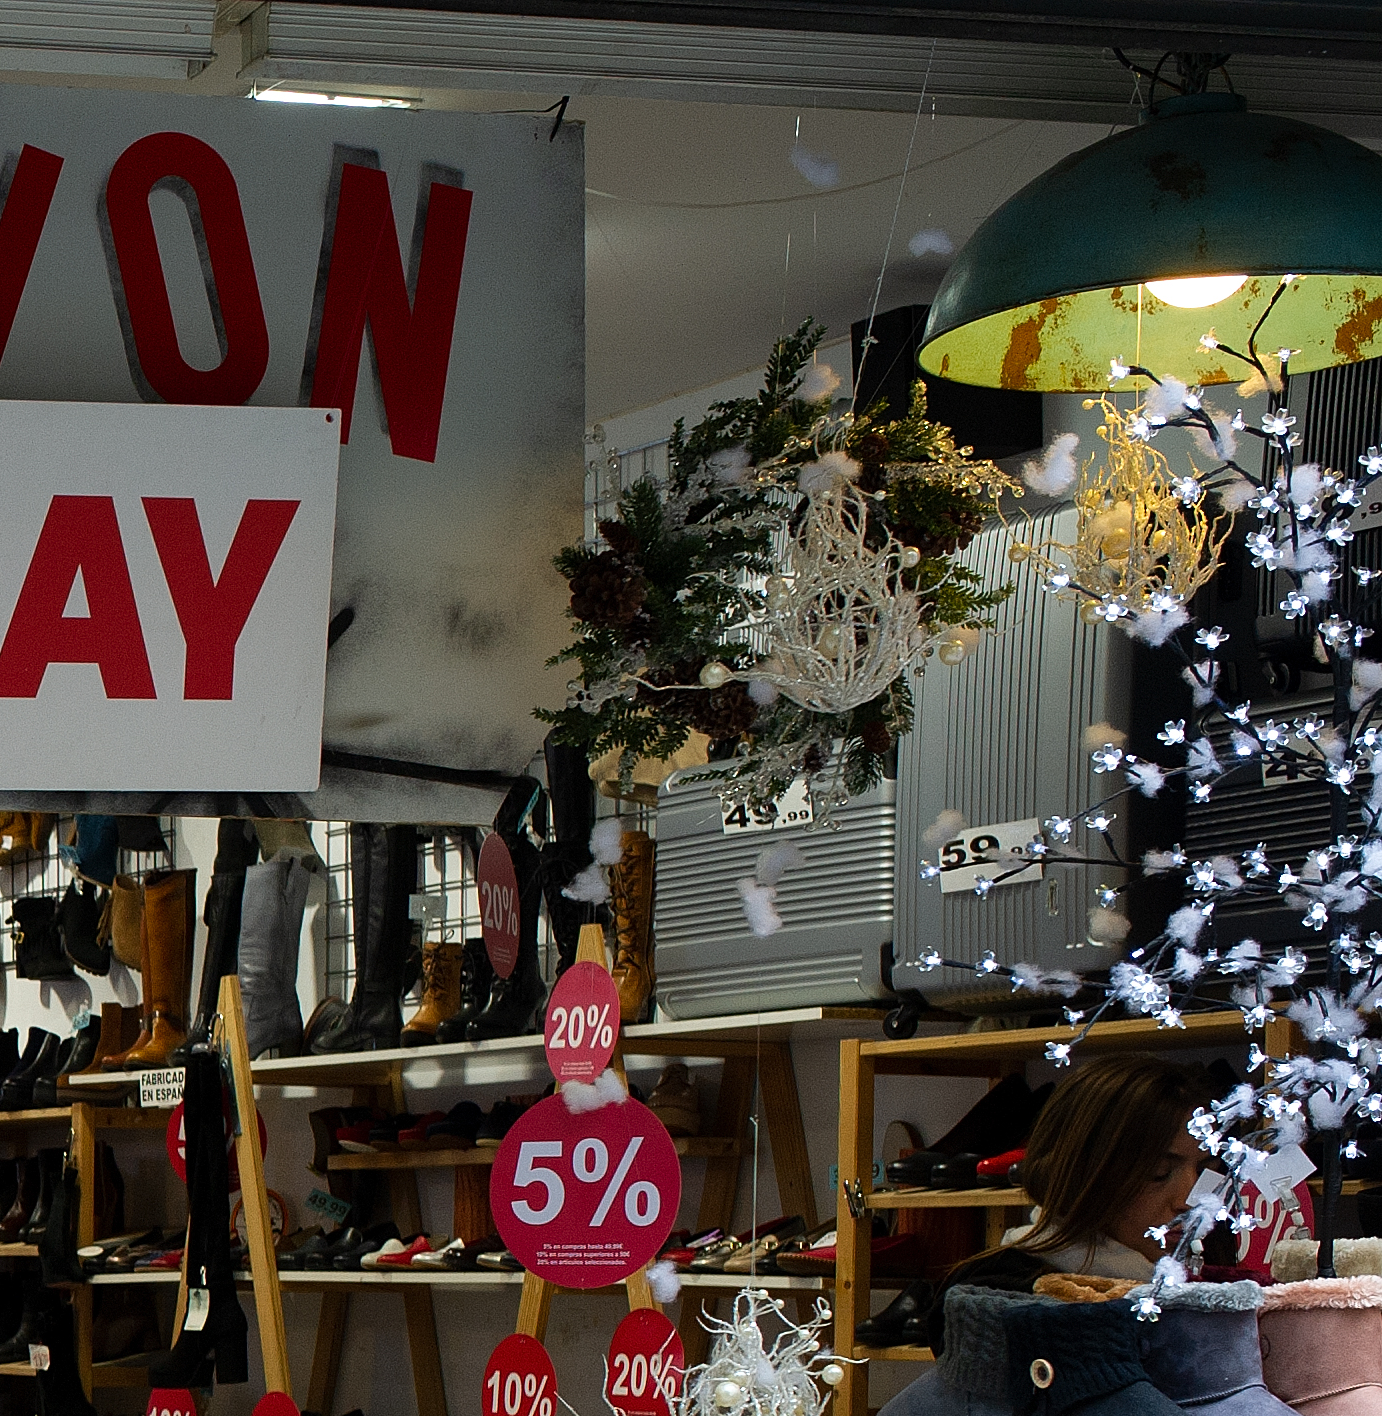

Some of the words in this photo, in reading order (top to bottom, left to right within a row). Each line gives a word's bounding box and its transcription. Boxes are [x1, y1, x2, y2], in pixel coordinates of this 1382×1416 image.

[480, 881, 517, 938] 20%
[549, 1004, 612, 1048] 20%
[141, 1071, 184, 1087] FABRICAD
[142, 1089, 154, 1102] EN
[155, 1085, 184, 1101] ESPAÑ
[511, 1137, 660, 1226] 5%
[612, 1352, 680, 1400] 20%
